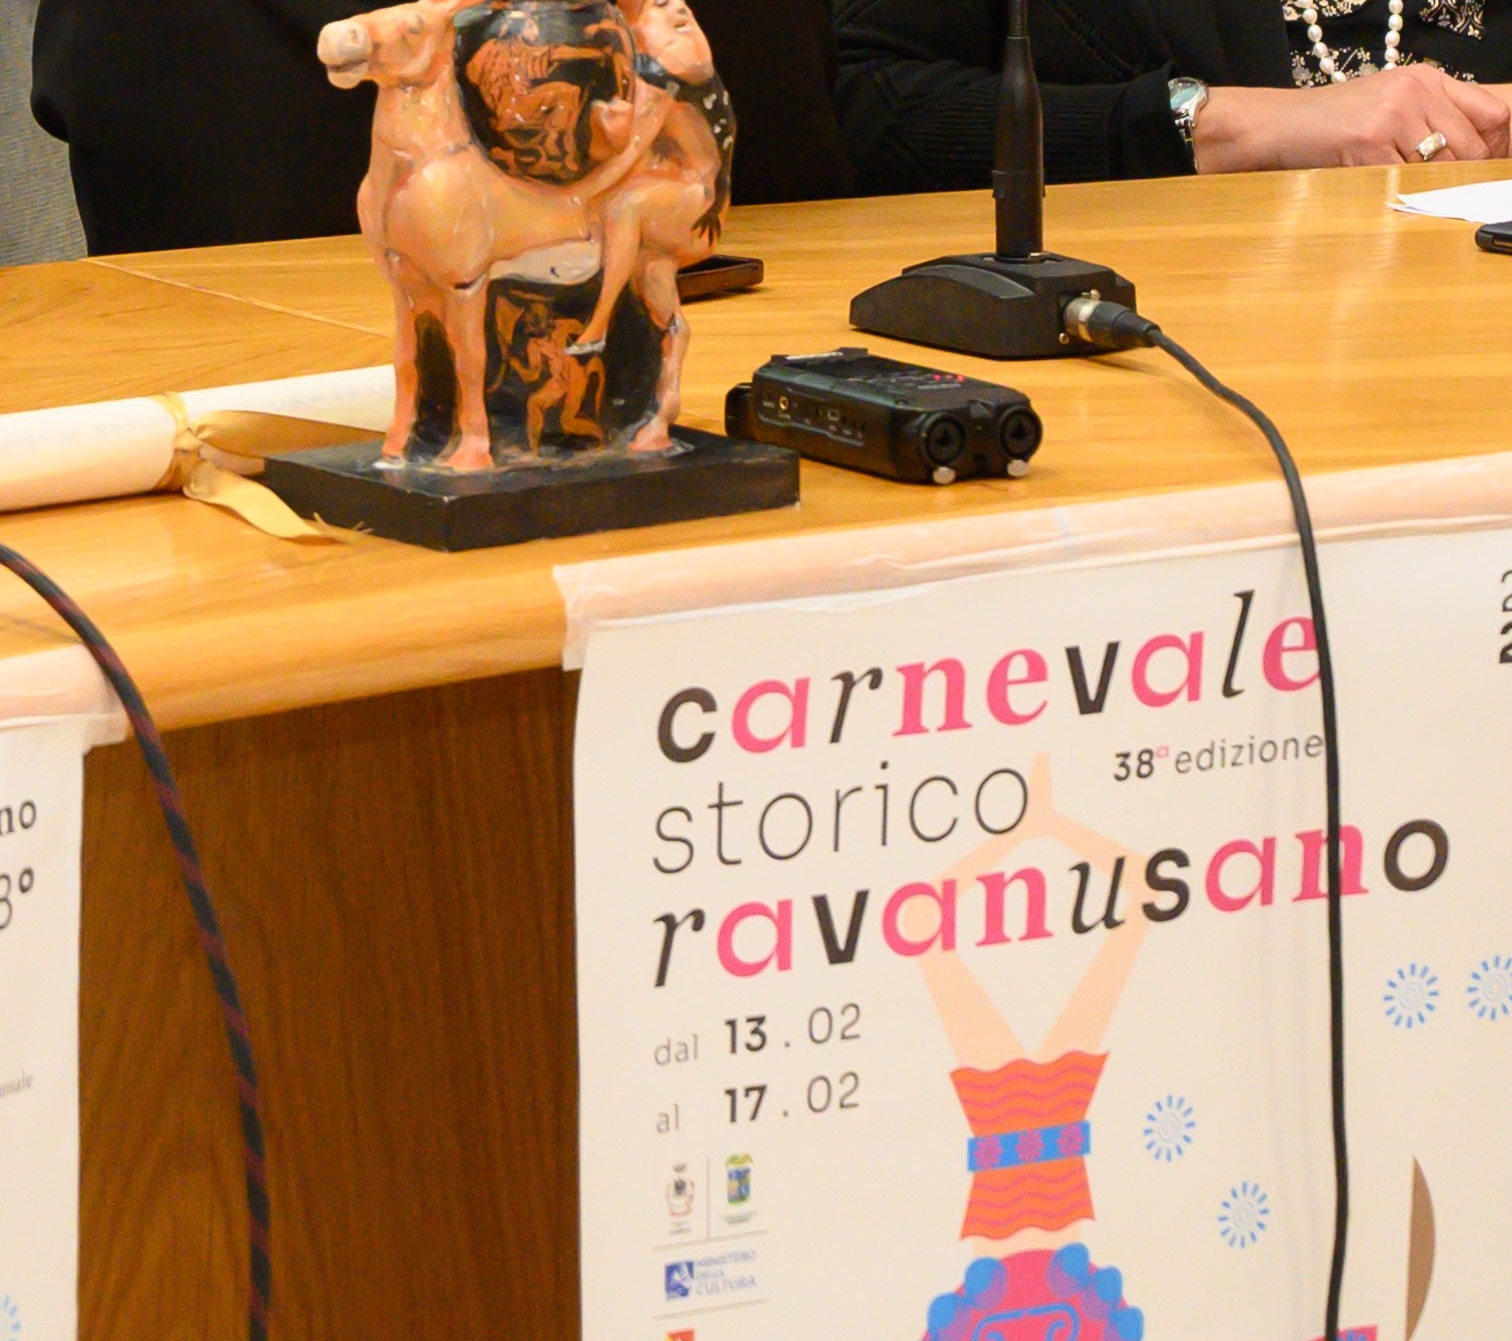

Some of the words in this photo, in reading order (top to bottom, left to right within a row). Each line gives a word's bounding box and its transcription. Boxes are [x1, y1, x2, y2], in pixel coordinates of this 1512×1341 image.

[656, 588, 1324, 765] carnevale
[653, 760, 1028, 875] storico
[1174, 731, 1323, 776] edizione
[652, 817, 1450, 988] ravanusano
[654, 1033, 698, 1066] dal
[656, 1103, 680, 1134] al
